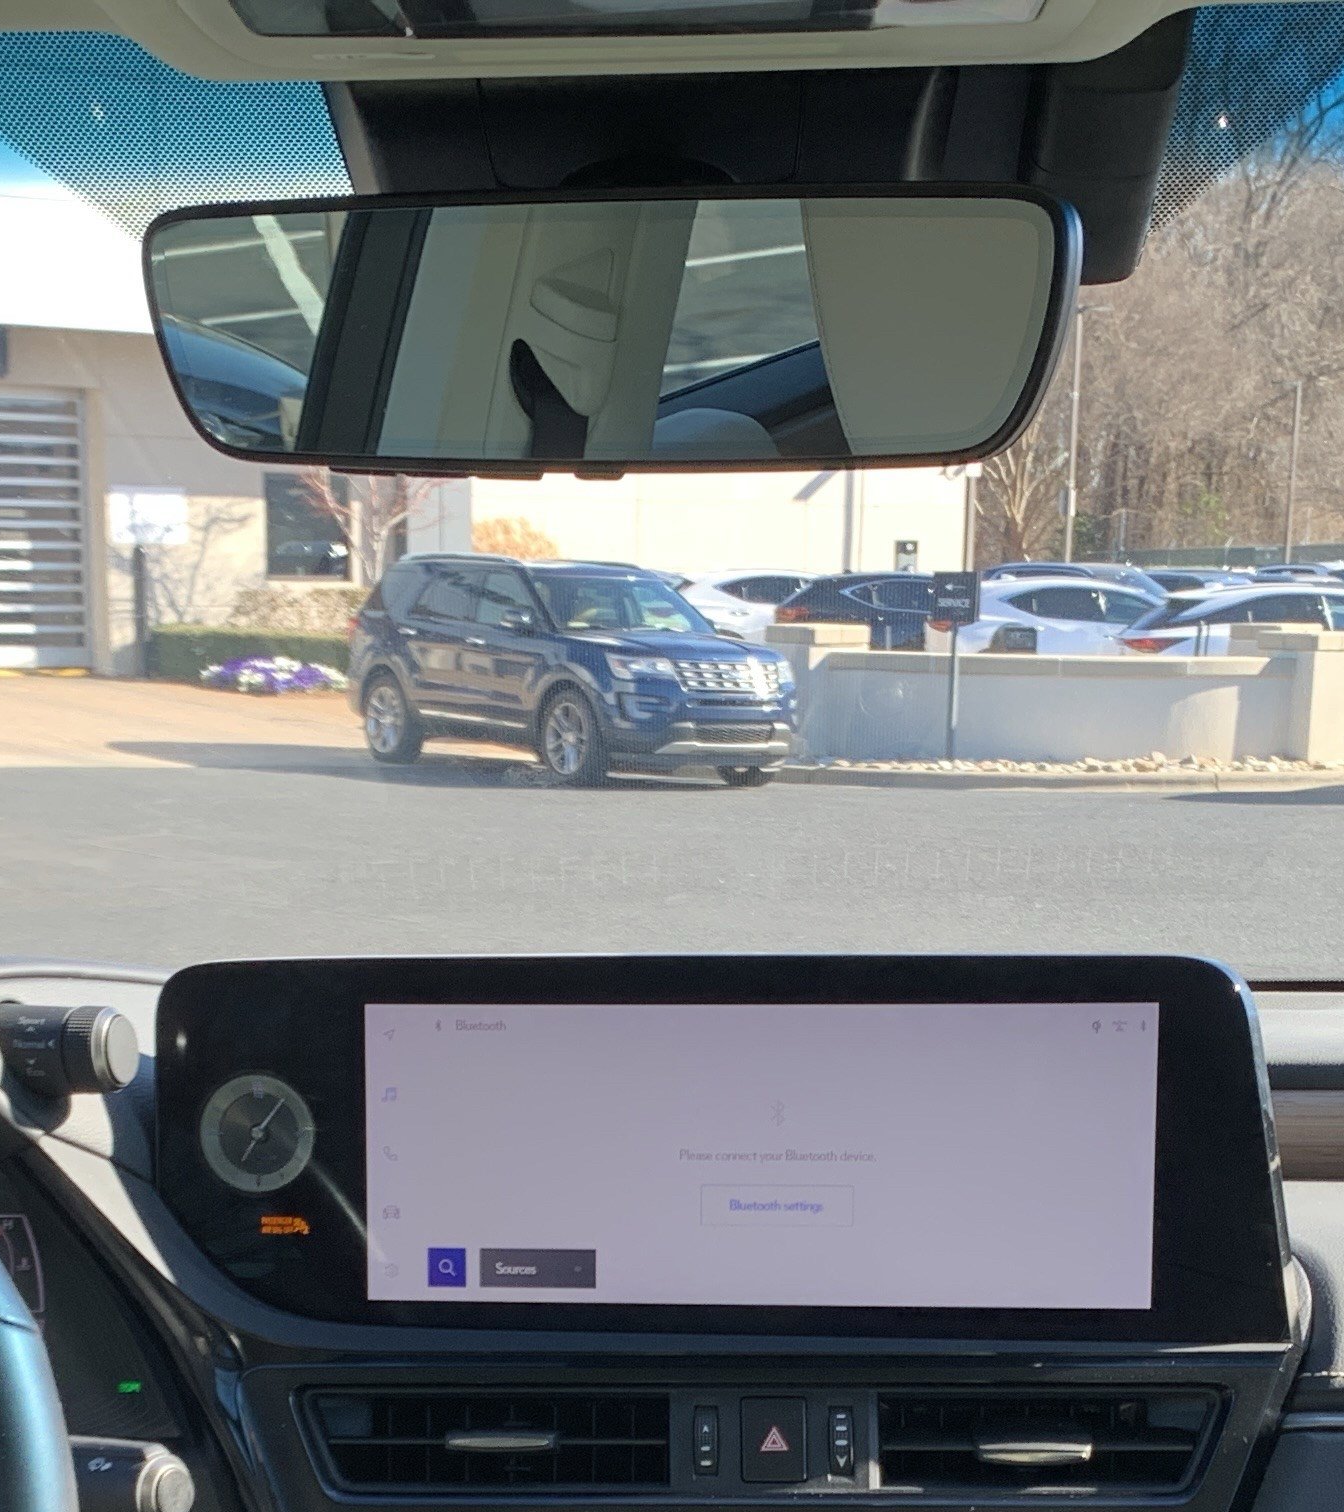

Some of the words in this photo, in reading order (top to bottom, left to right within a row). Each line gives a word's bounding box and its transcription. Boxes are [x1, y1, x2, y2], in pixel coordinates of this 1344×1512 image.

[455, 1018, 507, 1031] Bluetooth
[678, 1148, 713, 1161] Please
[714, 1151, 758, 1161] connect
[759, 1152, 783, 1164] your
[784, 1149, 837, 1162] Bluetooth
[728, 1199, 781, 1212] Bluetooth
[783, 1200, 823, 1214] settings
[494, 1261, 538, 1275] Sources
